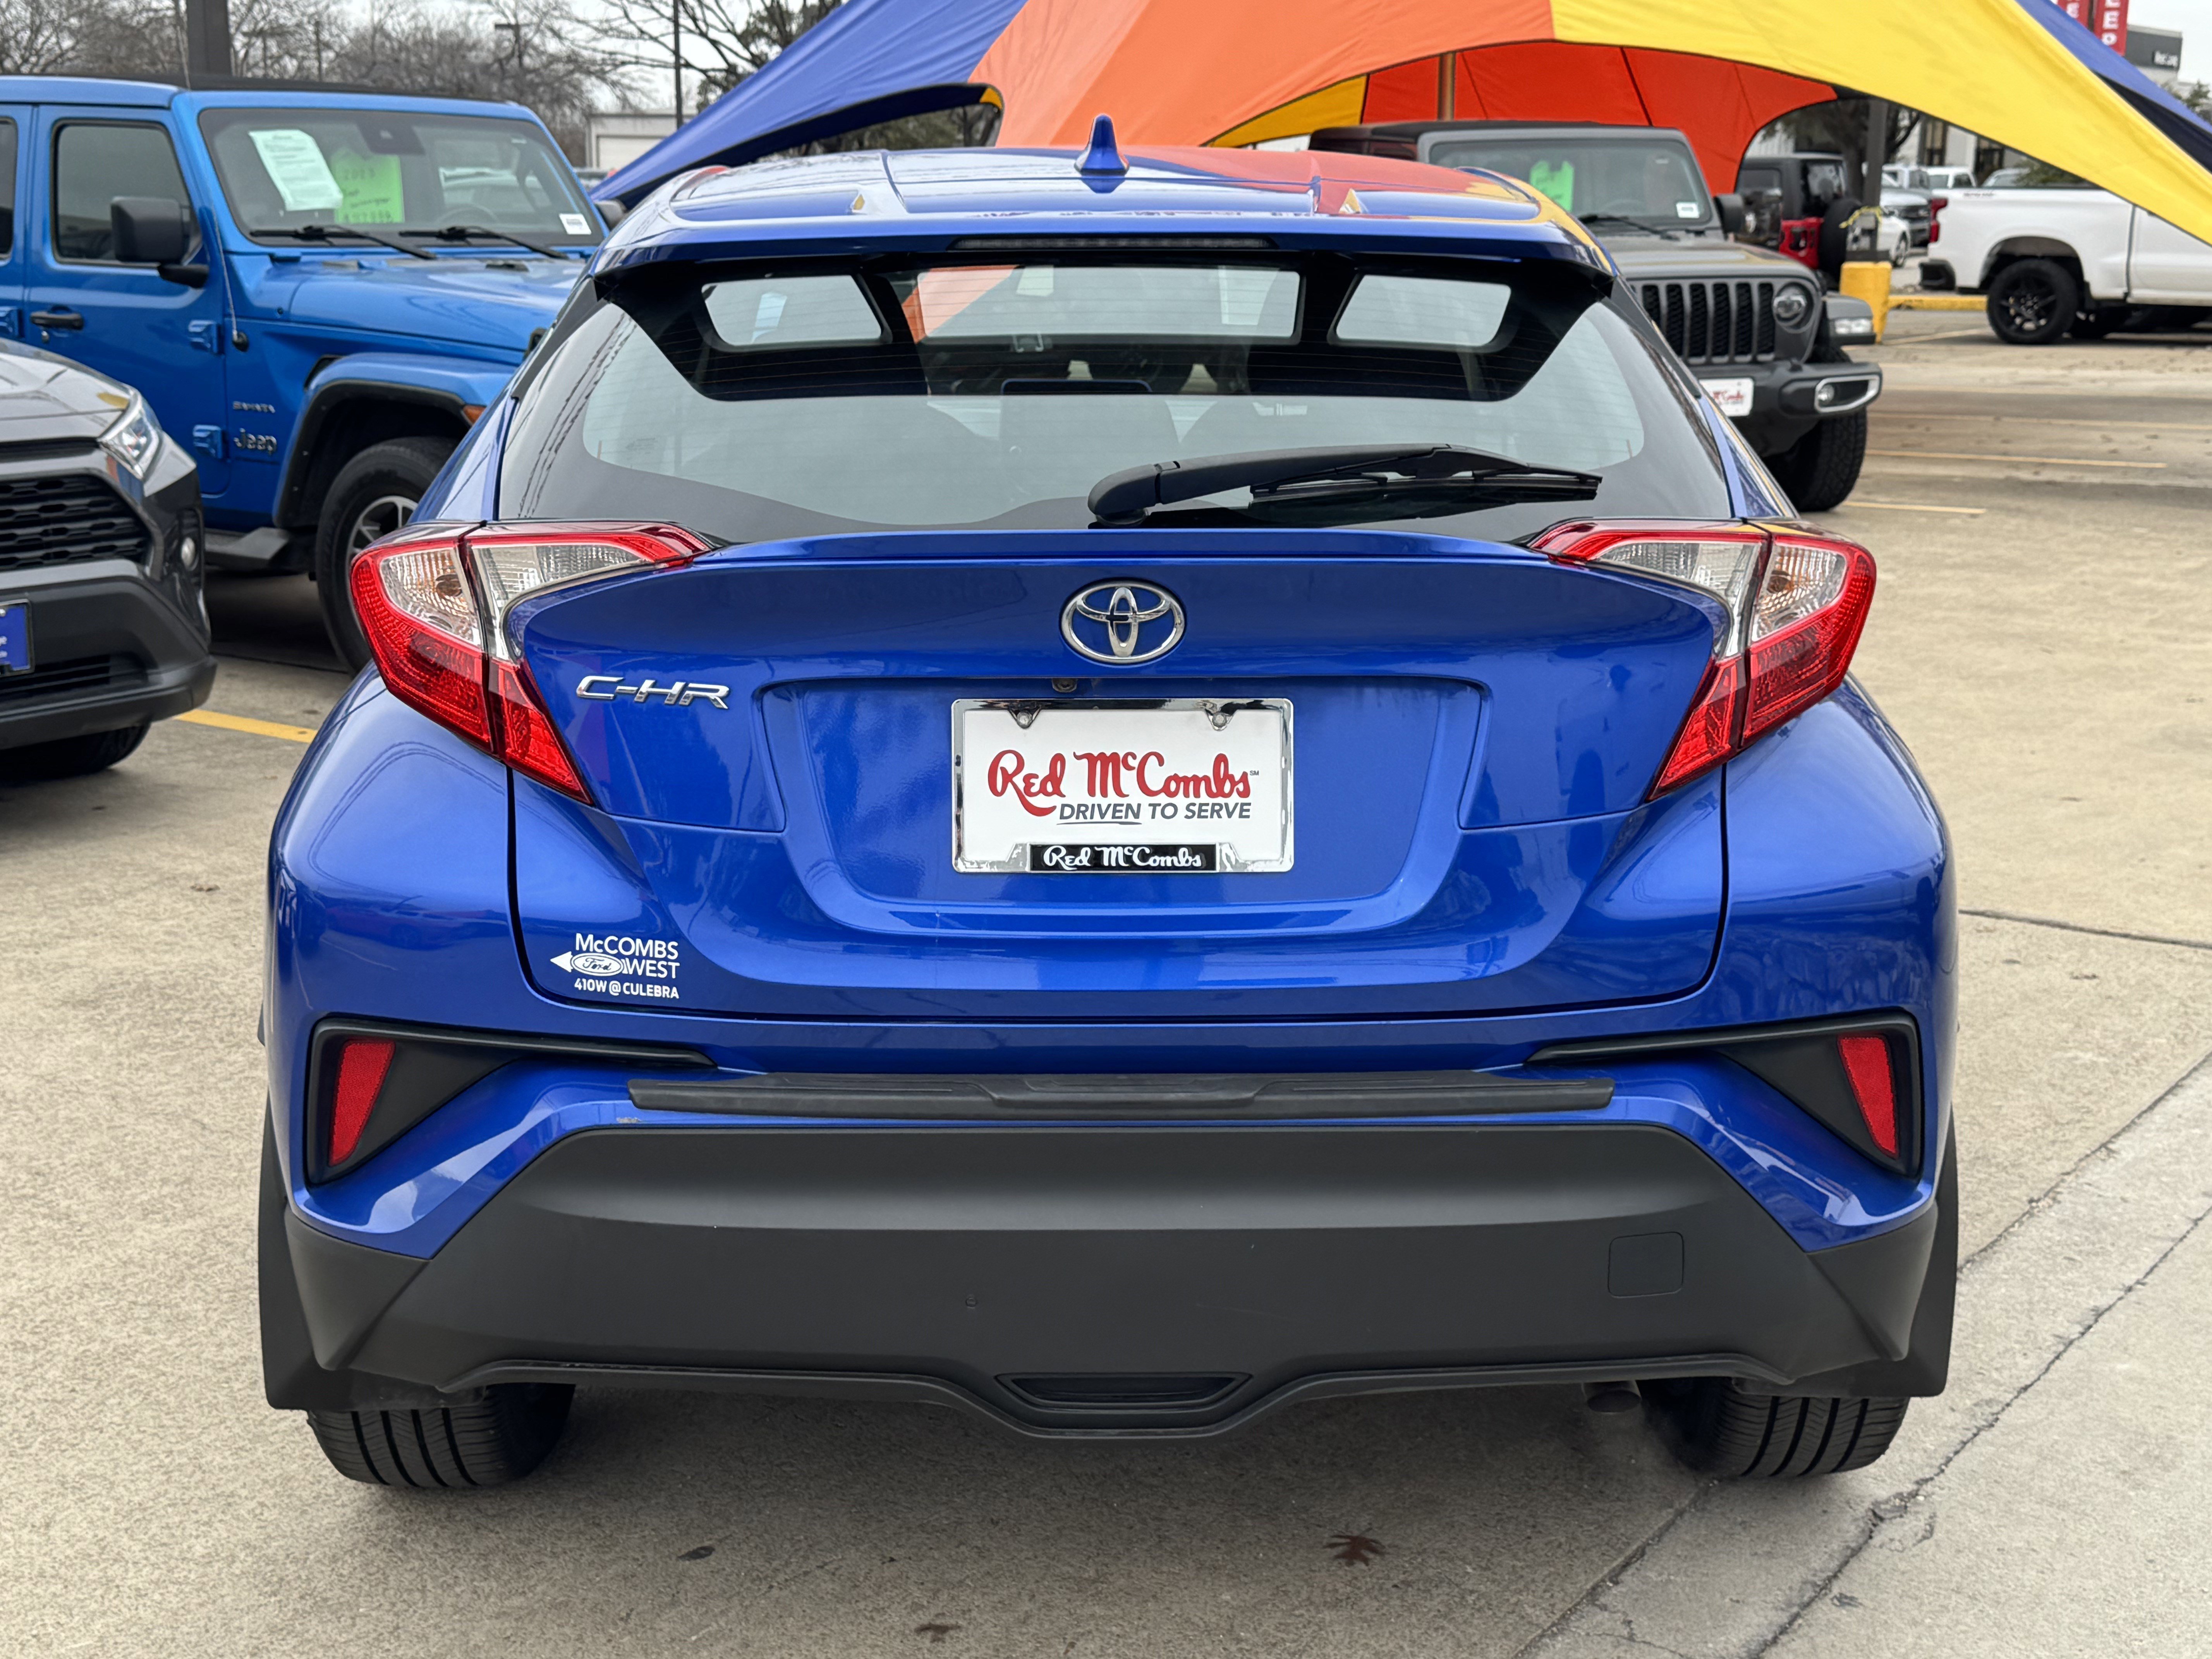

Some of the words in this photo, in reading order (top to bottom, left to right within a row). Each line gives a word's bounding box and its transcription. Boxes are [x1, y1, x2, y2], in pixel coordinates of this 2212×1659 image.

[233, 427, 277, 456] Jeep
[576, 675, 730, 709] C-HR
[988, 750, 1065, 816] Red
[1073, 751, 1251, 798] McCombs
[1059, 803, 1142, 820] DRIVEN
[1148, 803, 1178, 819] TO
[1184, 802, 1251, 819] SERVE
[1043, 845, 1091, 871] Red
[1094, 846, 1202, 867] McCombs
[575, 933, 678, 960] McCOMBS
[582, 957, 612, 971] Ford
[628, 958, 680, 979] WEST
